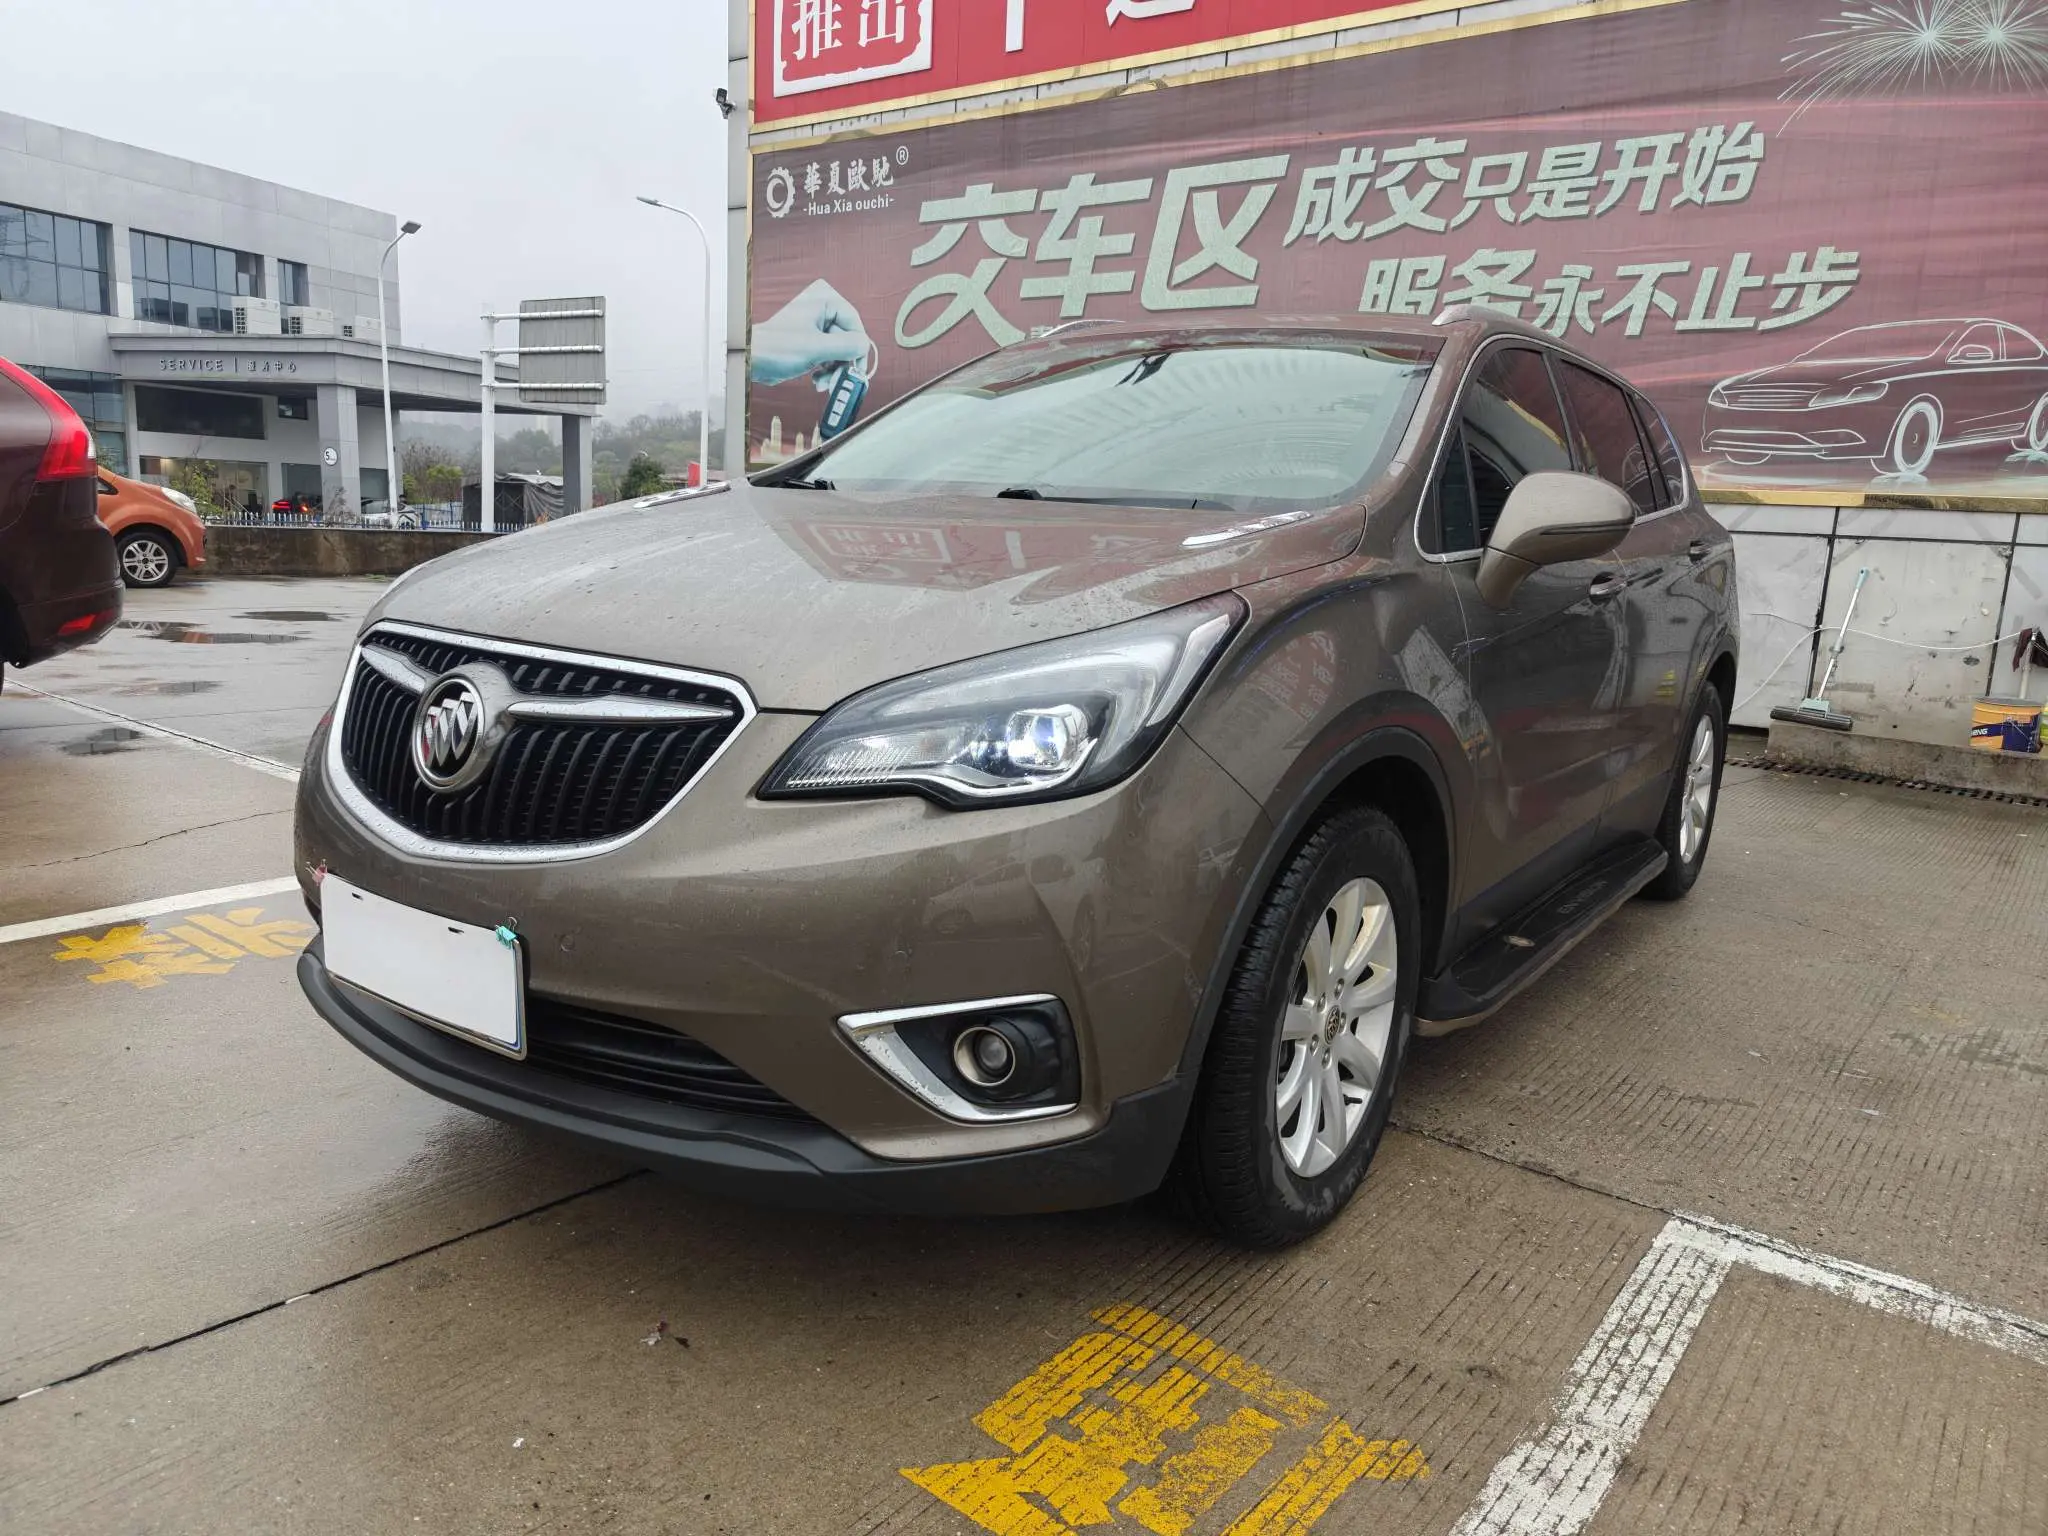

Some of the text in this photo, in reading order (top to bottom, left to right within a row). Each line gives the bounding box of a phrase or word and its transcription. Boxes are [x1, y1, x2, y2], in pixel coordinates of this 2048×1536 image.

[791, 0, 905, 59] 推出
[833, 199, 855, 213] Xia
[1282, 121, 1765, 247] 成交只是开始
[894, 154, 1290, 348] 交车区
[1357, 246, 1861, 339] 服务永不止步
[159, 358, 224, 372] SERVICE
